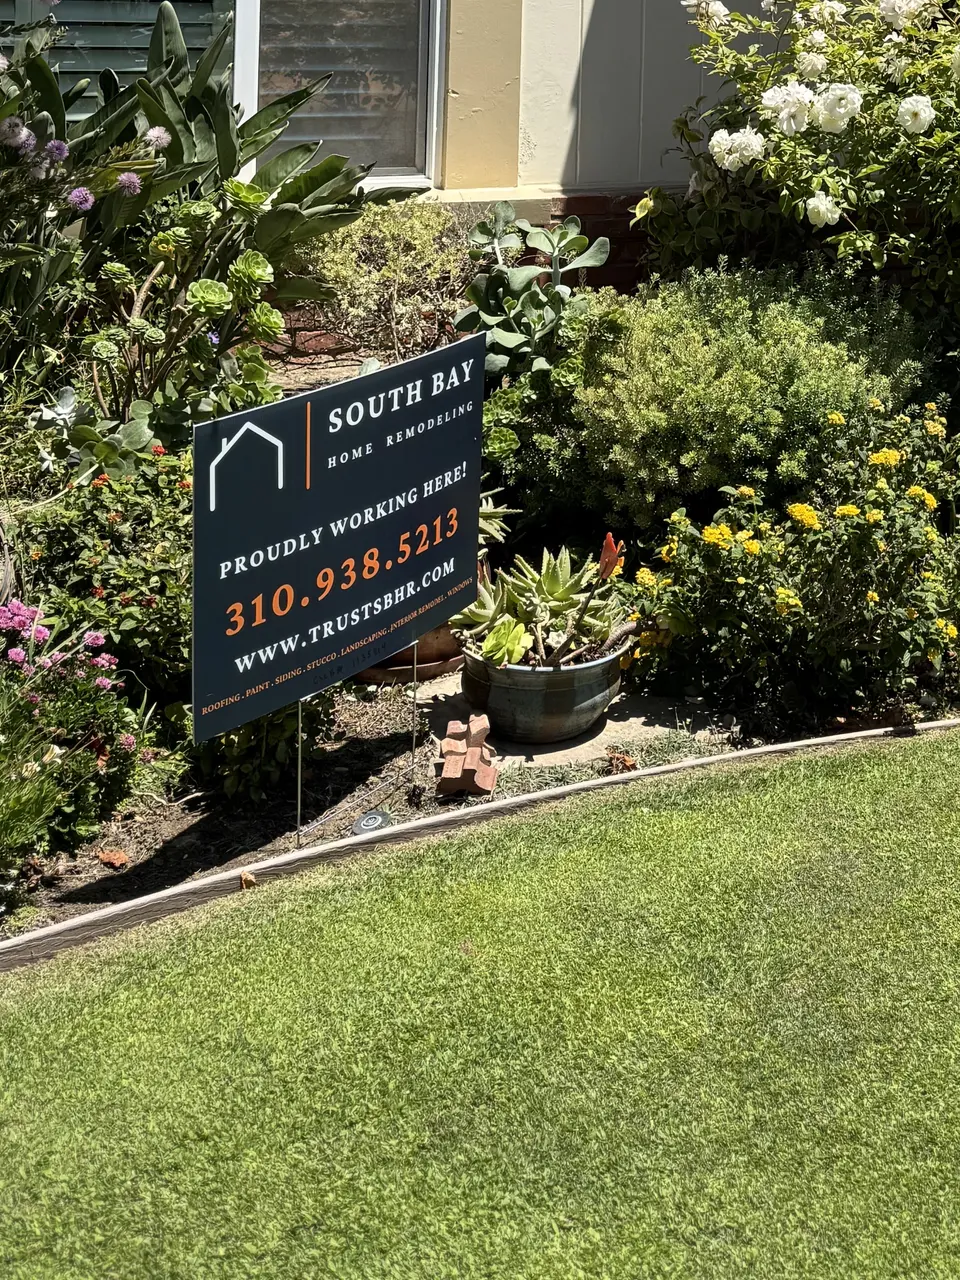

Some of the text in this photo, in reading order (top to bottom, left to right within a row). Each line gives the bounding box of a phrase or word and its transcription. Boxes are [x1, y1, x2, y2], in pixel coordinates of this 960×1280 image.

[327, 401, 474, 468] HOME REMODELING
[328, 358, 474, 433] SOUTH BAY
[219, 461, 467, 579] PROUDLY WORKING HERE!
[225, 507, 459, 636] 310.938.5213
[201, 694, 240, 715] ROOFING
[245, 681, 271, 697] PAINT
[275, 667, 302, 685] SIDING
[306, 652, 337, 671] STUCCO
[341, 627, 387, 656] LANDSCAPING
[390, 609, 418, 633] INTERIOR
[418, 595, 445, 614] REMODEL
[447, 576, 473, 596] WINDOWS
[234, 558, 456, 673] WWW.TRUSTSBHR.COM
